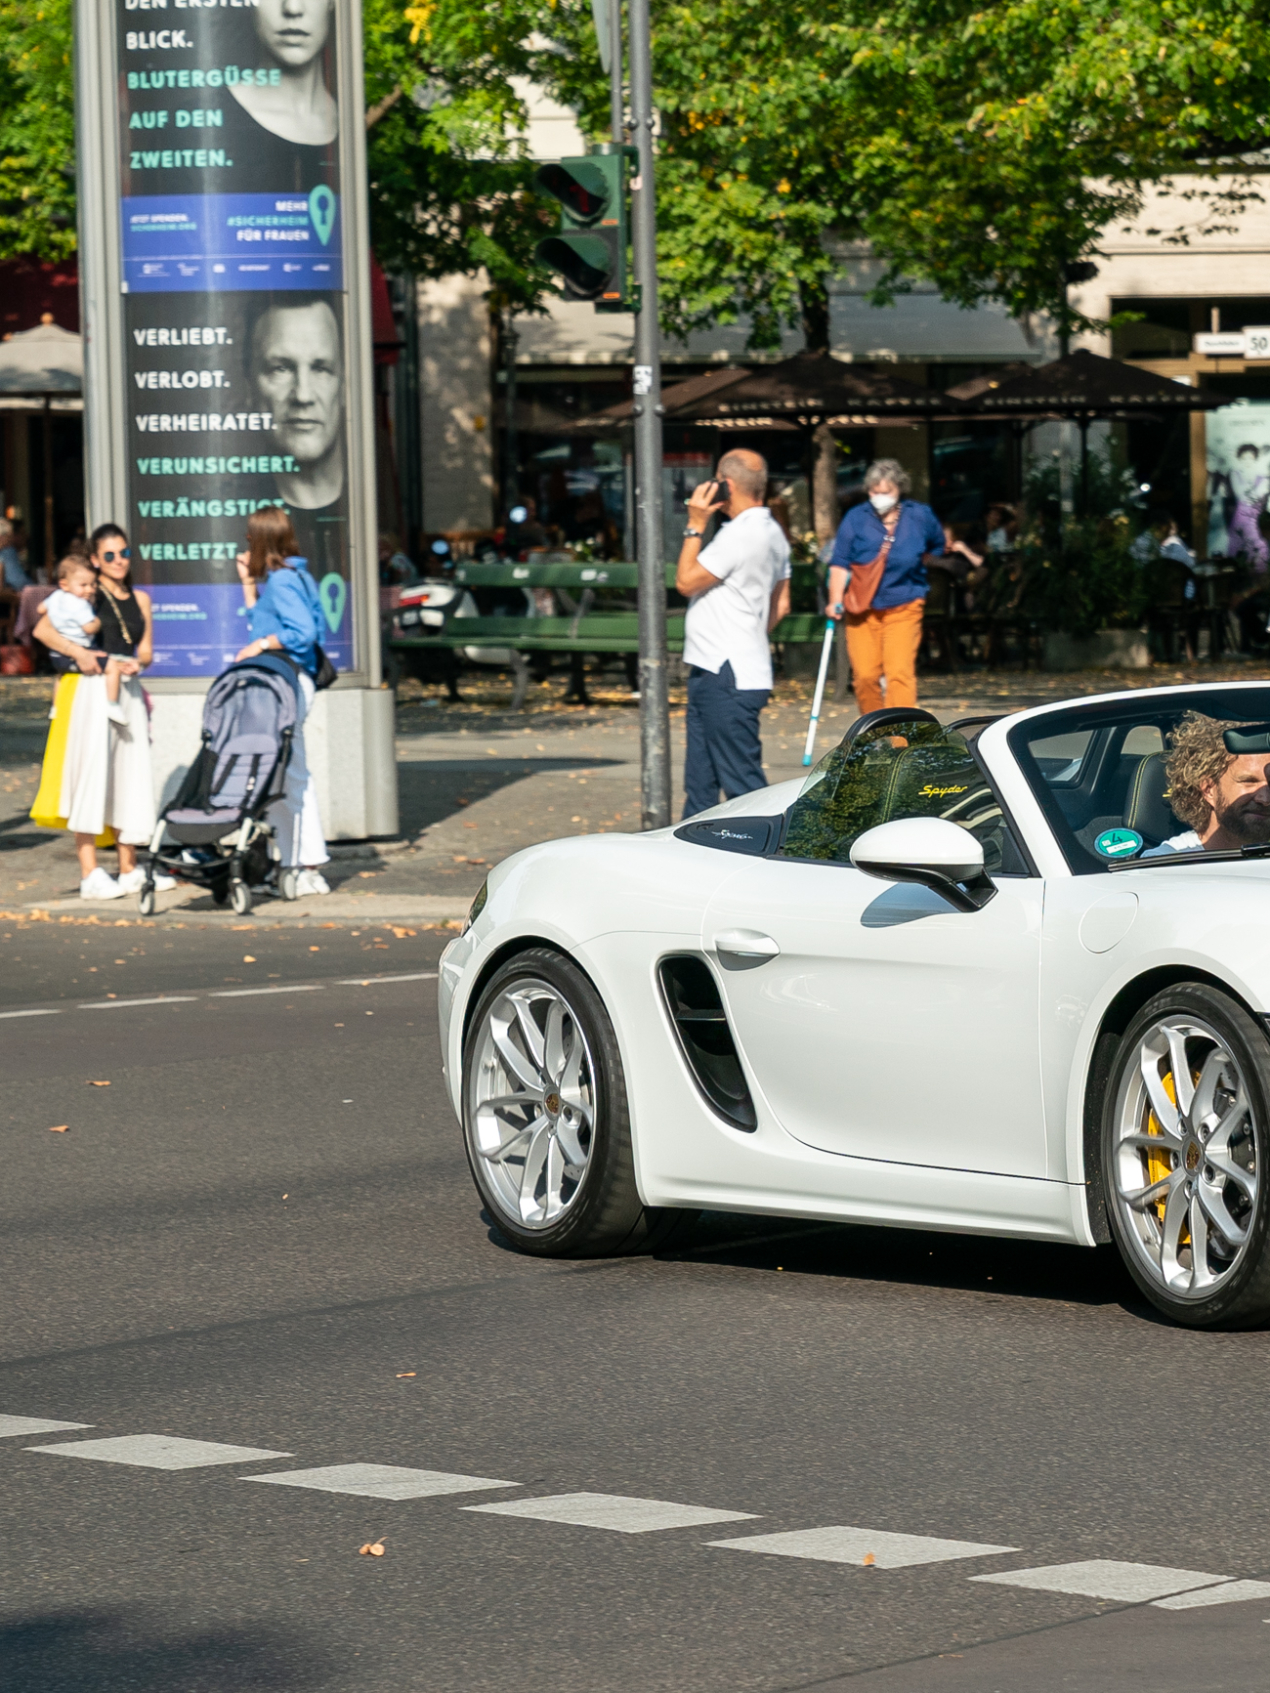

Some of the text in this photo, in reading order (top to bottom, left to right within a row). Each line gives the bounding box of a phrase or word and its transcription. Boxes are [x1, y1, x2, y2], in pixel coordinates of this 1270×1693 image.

[126, 30, 194, 50] BLICK.
[127, 66, 281, 89] BLUTERGÜSSE
[129, 109, 223, 129] AUF DEN
[130, 150, 233, 169] ZWEITEN.
[275, 201, 308, 212] MEHR
[237, 229, 309, 241] FÜR FRAUEN
[134, 328, 233, 346] VERLIEBT.
[1250, 337, 1268, 351] 50
[135, 371, 231, 389] VERLOBT.
[136, 413, 278, 433] VERHEIRATET.
[137, 456, 300, 475] VERUNSICHERT.
[918, 784, 968, 798] Spyder
[1112, 833, 1123, 843] 4
